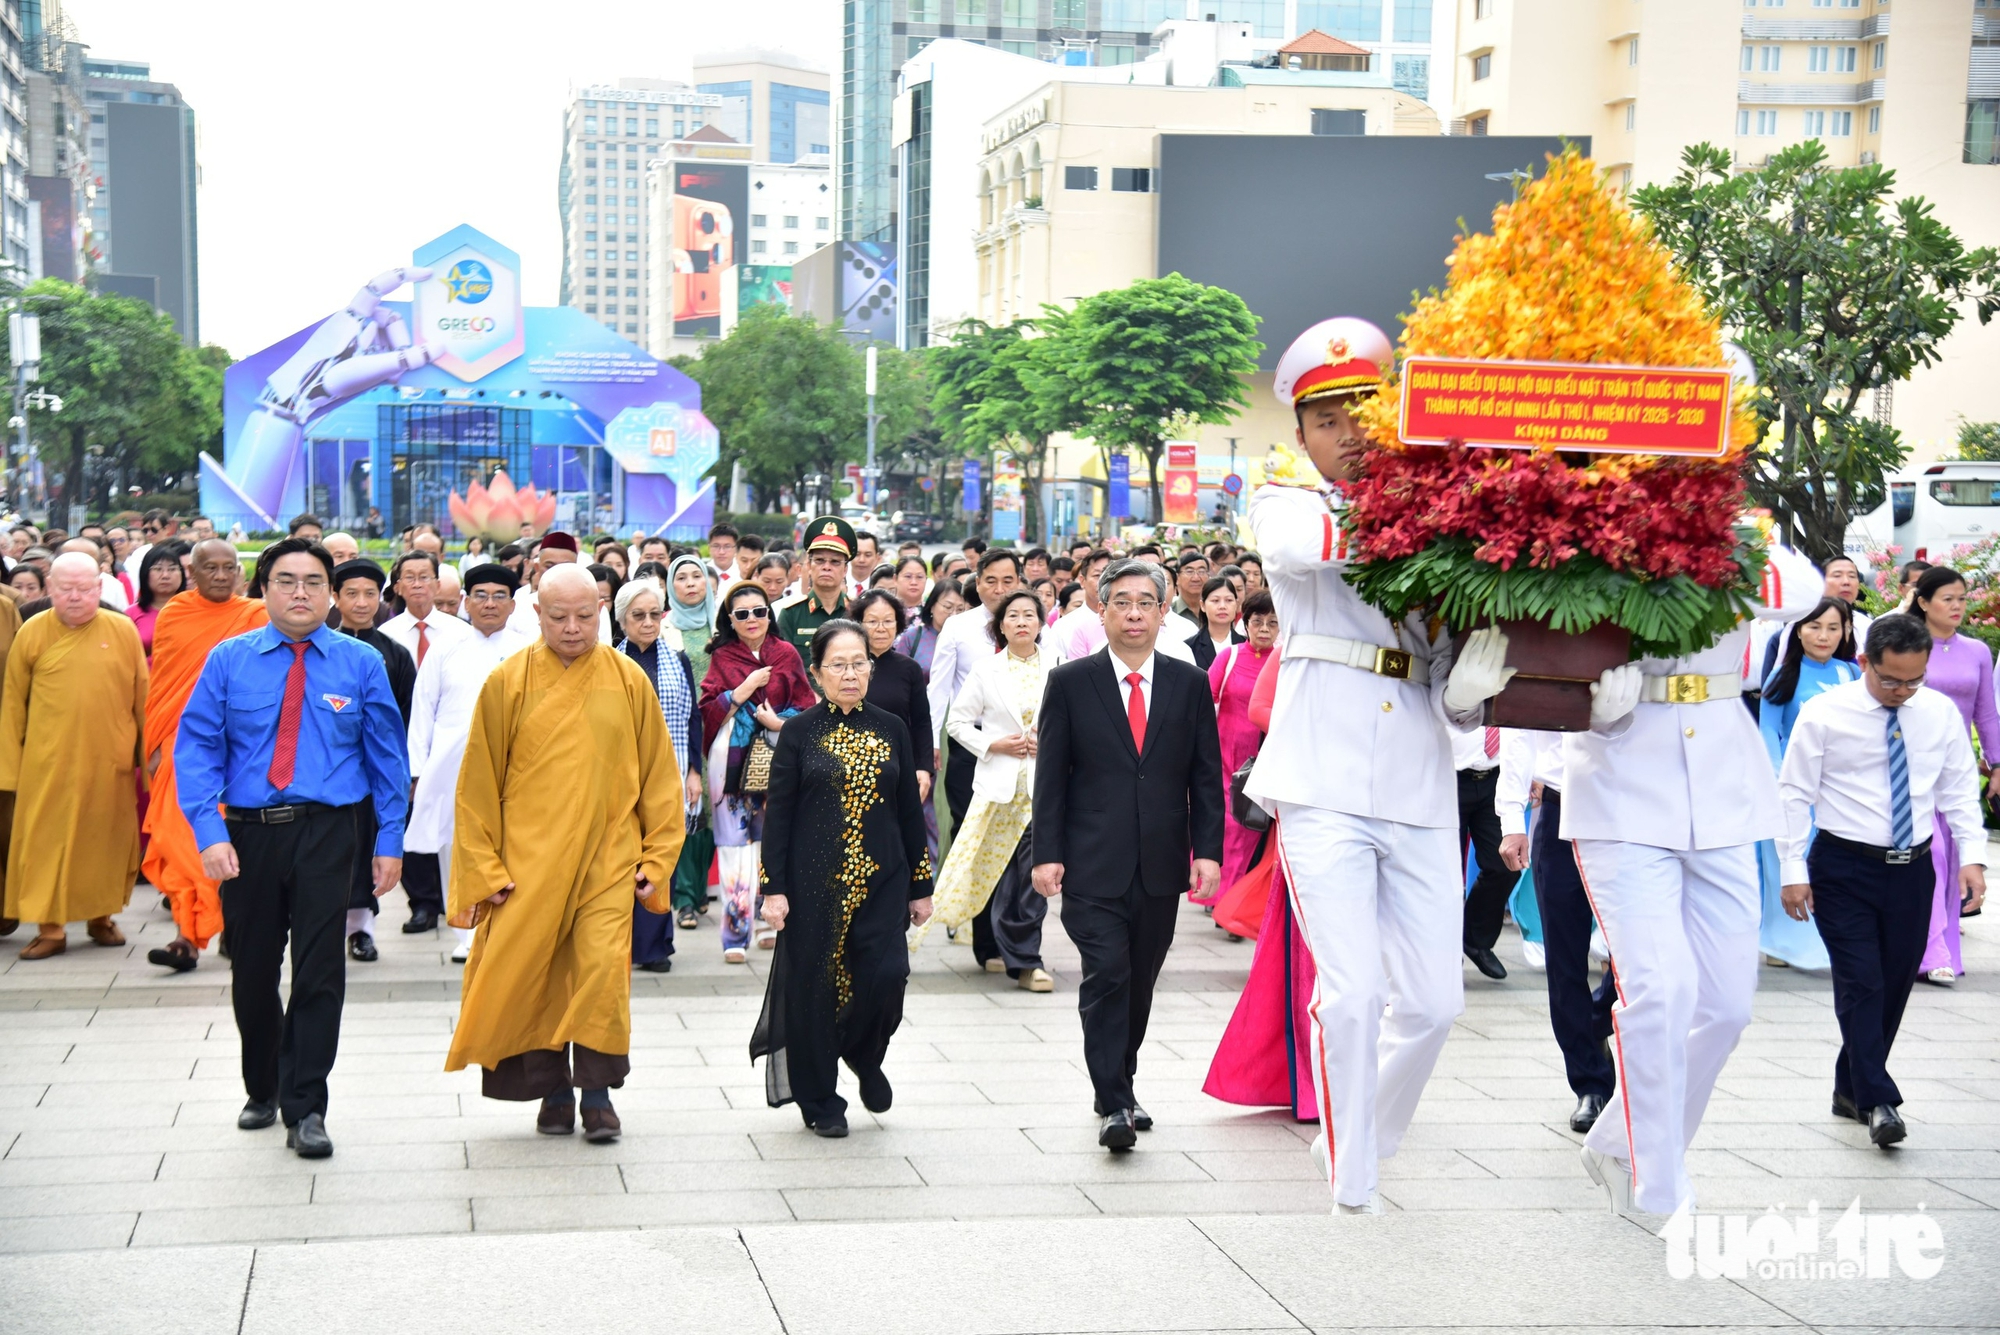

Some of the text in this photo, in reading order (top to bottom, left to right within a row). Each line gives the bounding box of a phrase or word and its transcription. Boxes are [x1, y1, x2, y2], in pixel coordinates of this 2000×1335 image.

[593, 89, 720, 105] HARBOUR VIEW TOWER
[438, 316, 495, 332] GRECO
[1412, 370, 1440, 389] ĐOÀN
[1441, 373, 1458, 393] ĐẠI
[1459, 369, 1483, 392] BIỂU
[1499, 376, 1516, 396] ĐẠI
[1517, 374, 1535, 397] HỘI
[1535, 377, 1553, 397] ĐẠI
[1554, 373, 1578, 396] BIỂU
[1602, 377, 1630, 400] TRẬN
[1631, 375, 1646, 398] TỔ
[1645, 378, 1673, 400] QUỐC
[1674, 380, 1697, 403] VIỆT
[1697, 383, 1722, 401] NAM
[1424, 395, 1458, 414] THÀNH
[1458, 395, 1481, 416] PHỐ
[1480, 396, 1495, 417] HỒ
[1495, 398, 1514, 418] CHÍ
[1513, 401, 1540, 418] MINH
[1541, 398, 1562, 419] LẦN
[1563, 400, 1583, 421] THỨ
[1592, 402, 1627, 425] NHIỆM
[1642, 406, 1670, 424] 2025
[1676, 407, 1706, 425] 2030
[1514, 422, 1609, 441] KÍNH DÂNG
[652, 432, 673, 451] AI
